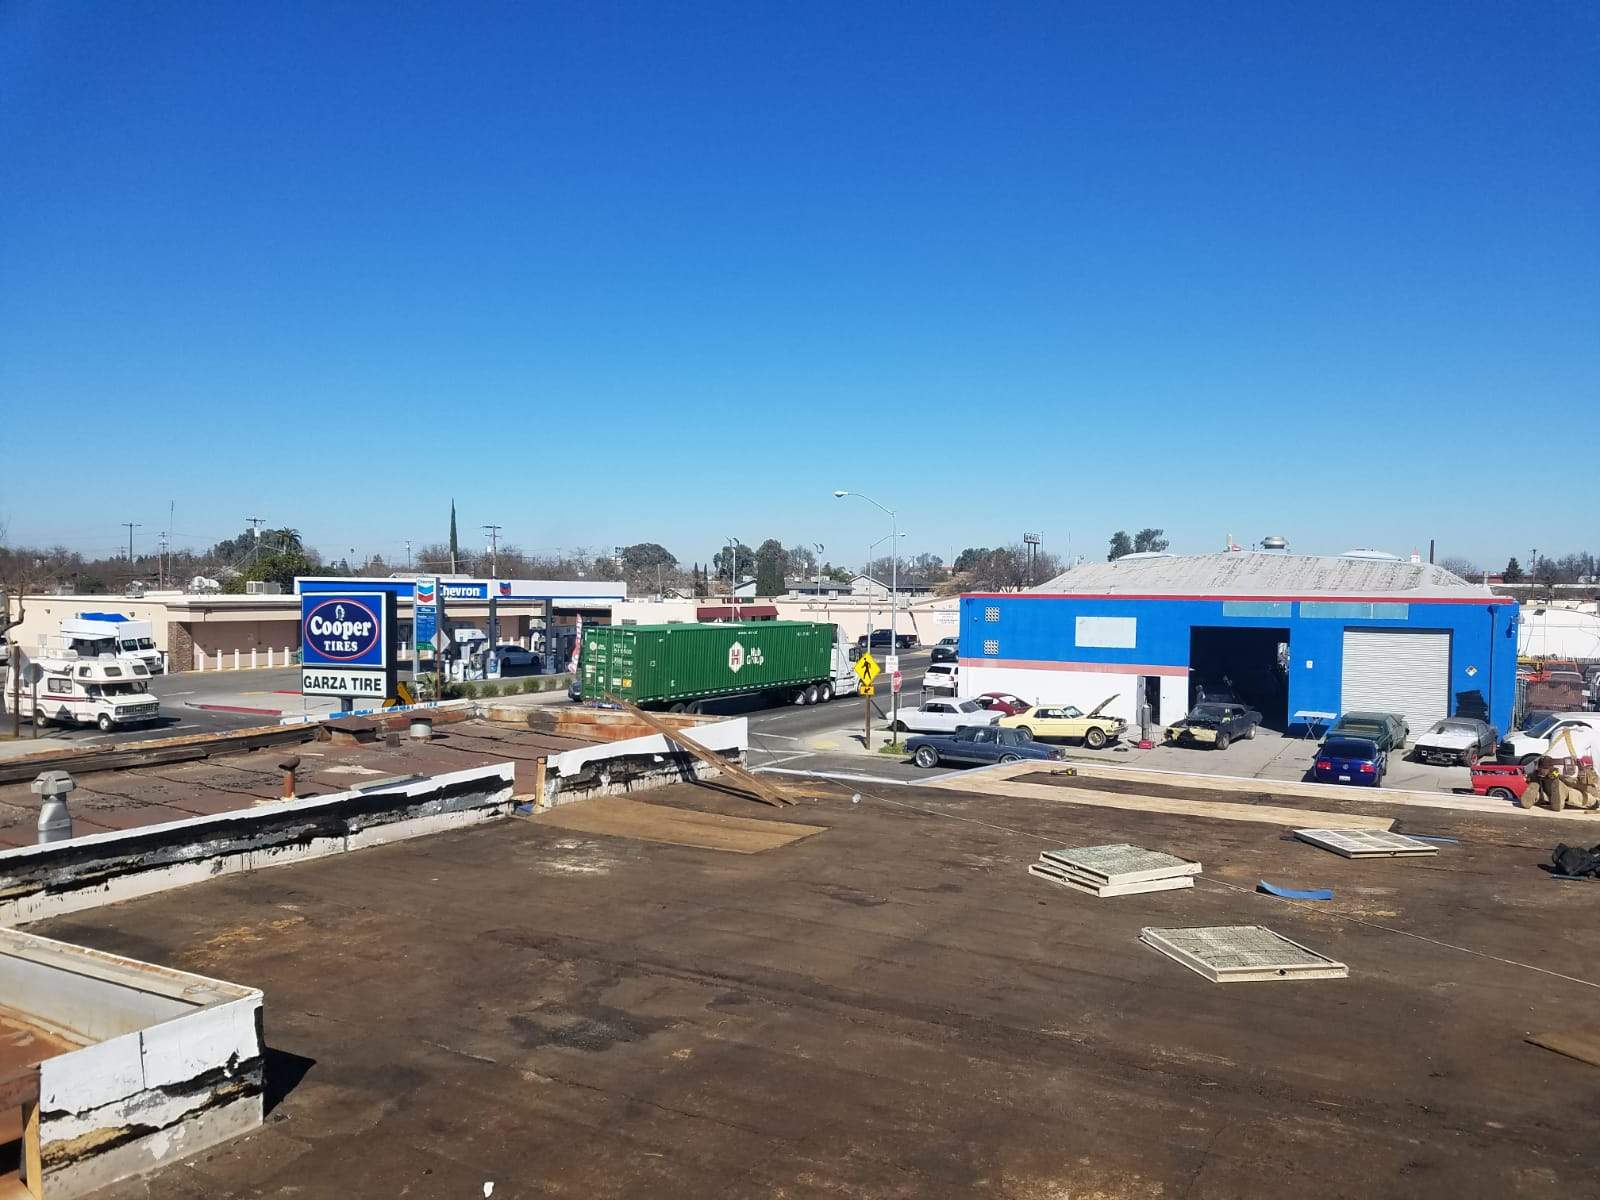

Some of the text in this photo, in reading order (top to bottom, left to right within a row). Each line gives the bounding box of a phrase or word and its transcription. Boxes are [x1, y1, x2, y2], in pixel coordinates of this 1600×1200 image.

[310, 615, 372, 640] Cooper
[323, 640, 358, 652] TIRES
[303, 674, 382, 692] GARZA TIRE
